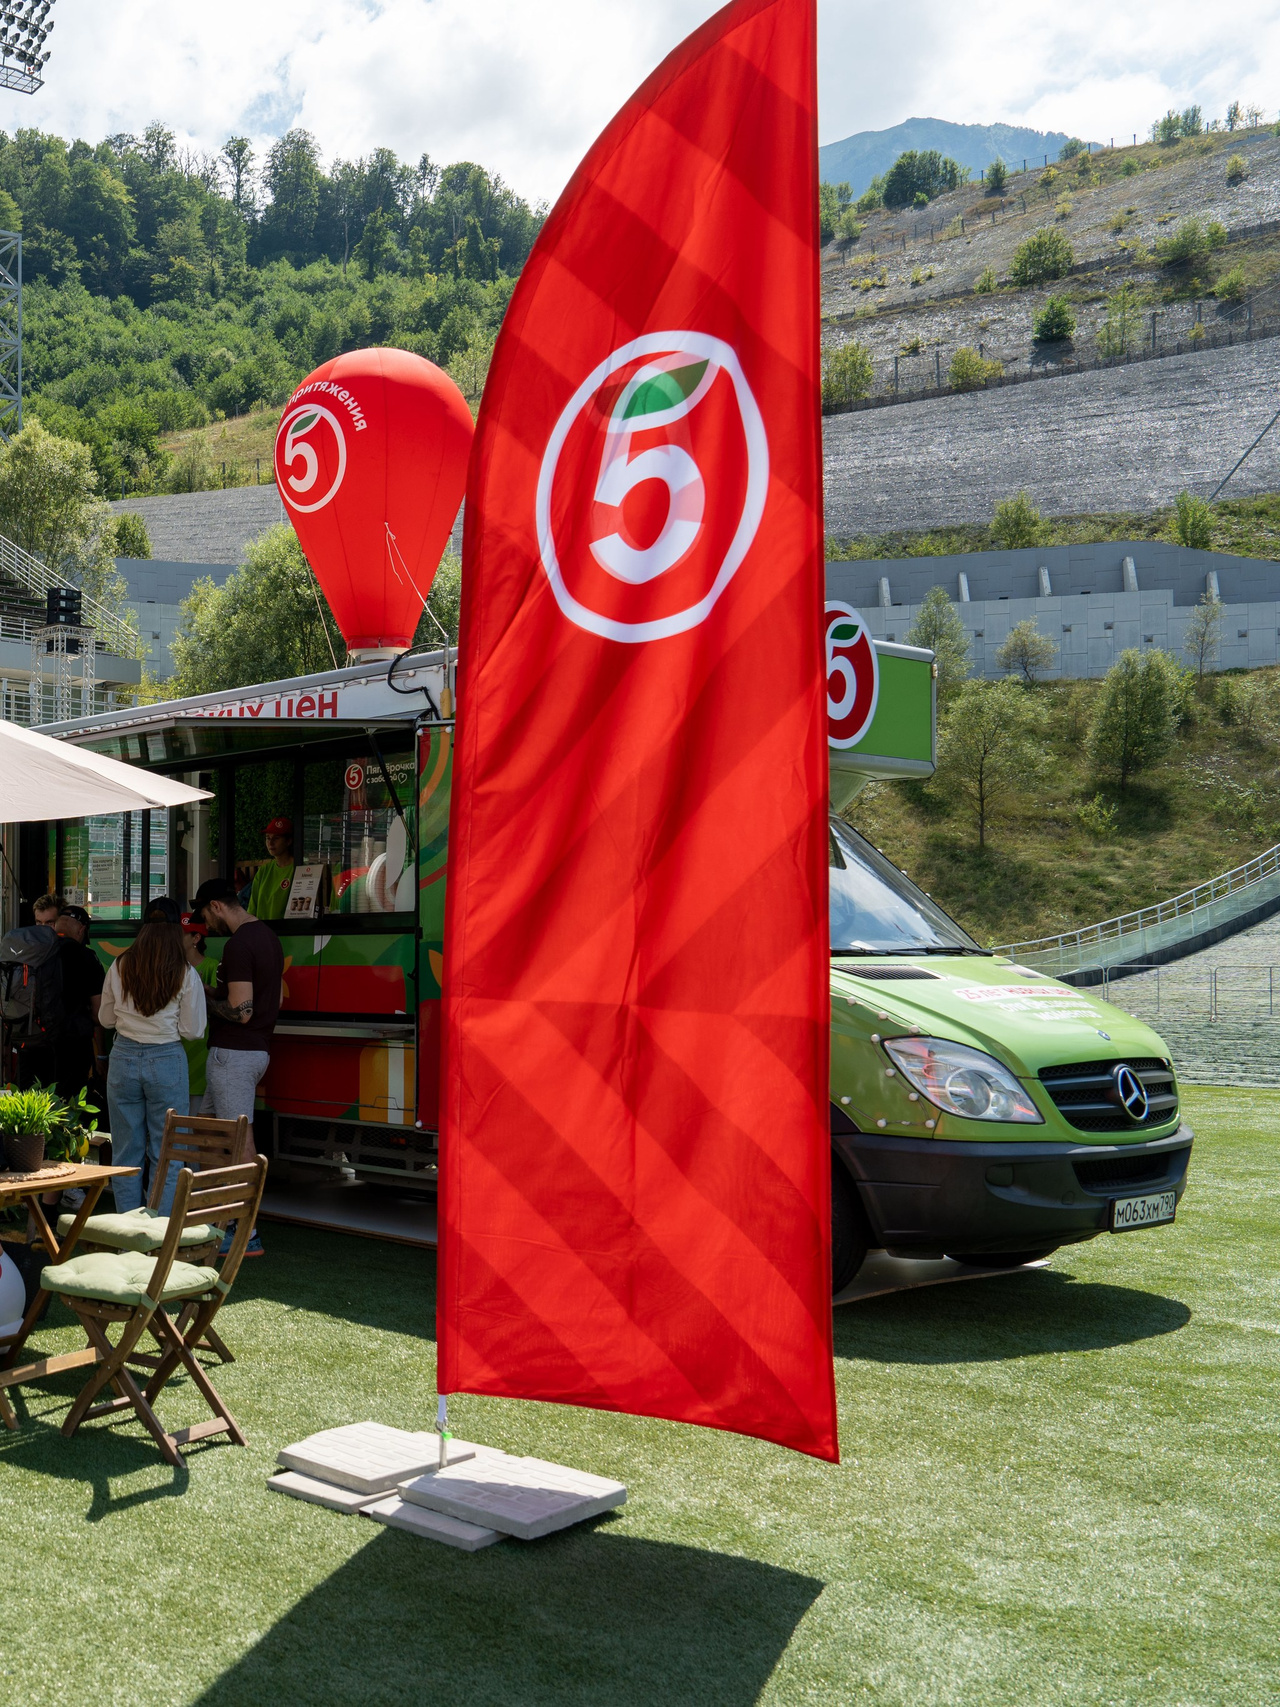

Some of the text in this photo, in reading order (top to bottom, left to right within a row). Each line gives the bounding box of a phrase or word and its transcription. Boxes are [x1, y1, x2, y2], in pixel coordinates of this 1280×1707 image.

[287, 381, 368, 432] притяжения
[284, 407, 321, 493] 5
[349, 765, 361, 785] 5
[1160, 1194, 1174, 1211] 790
